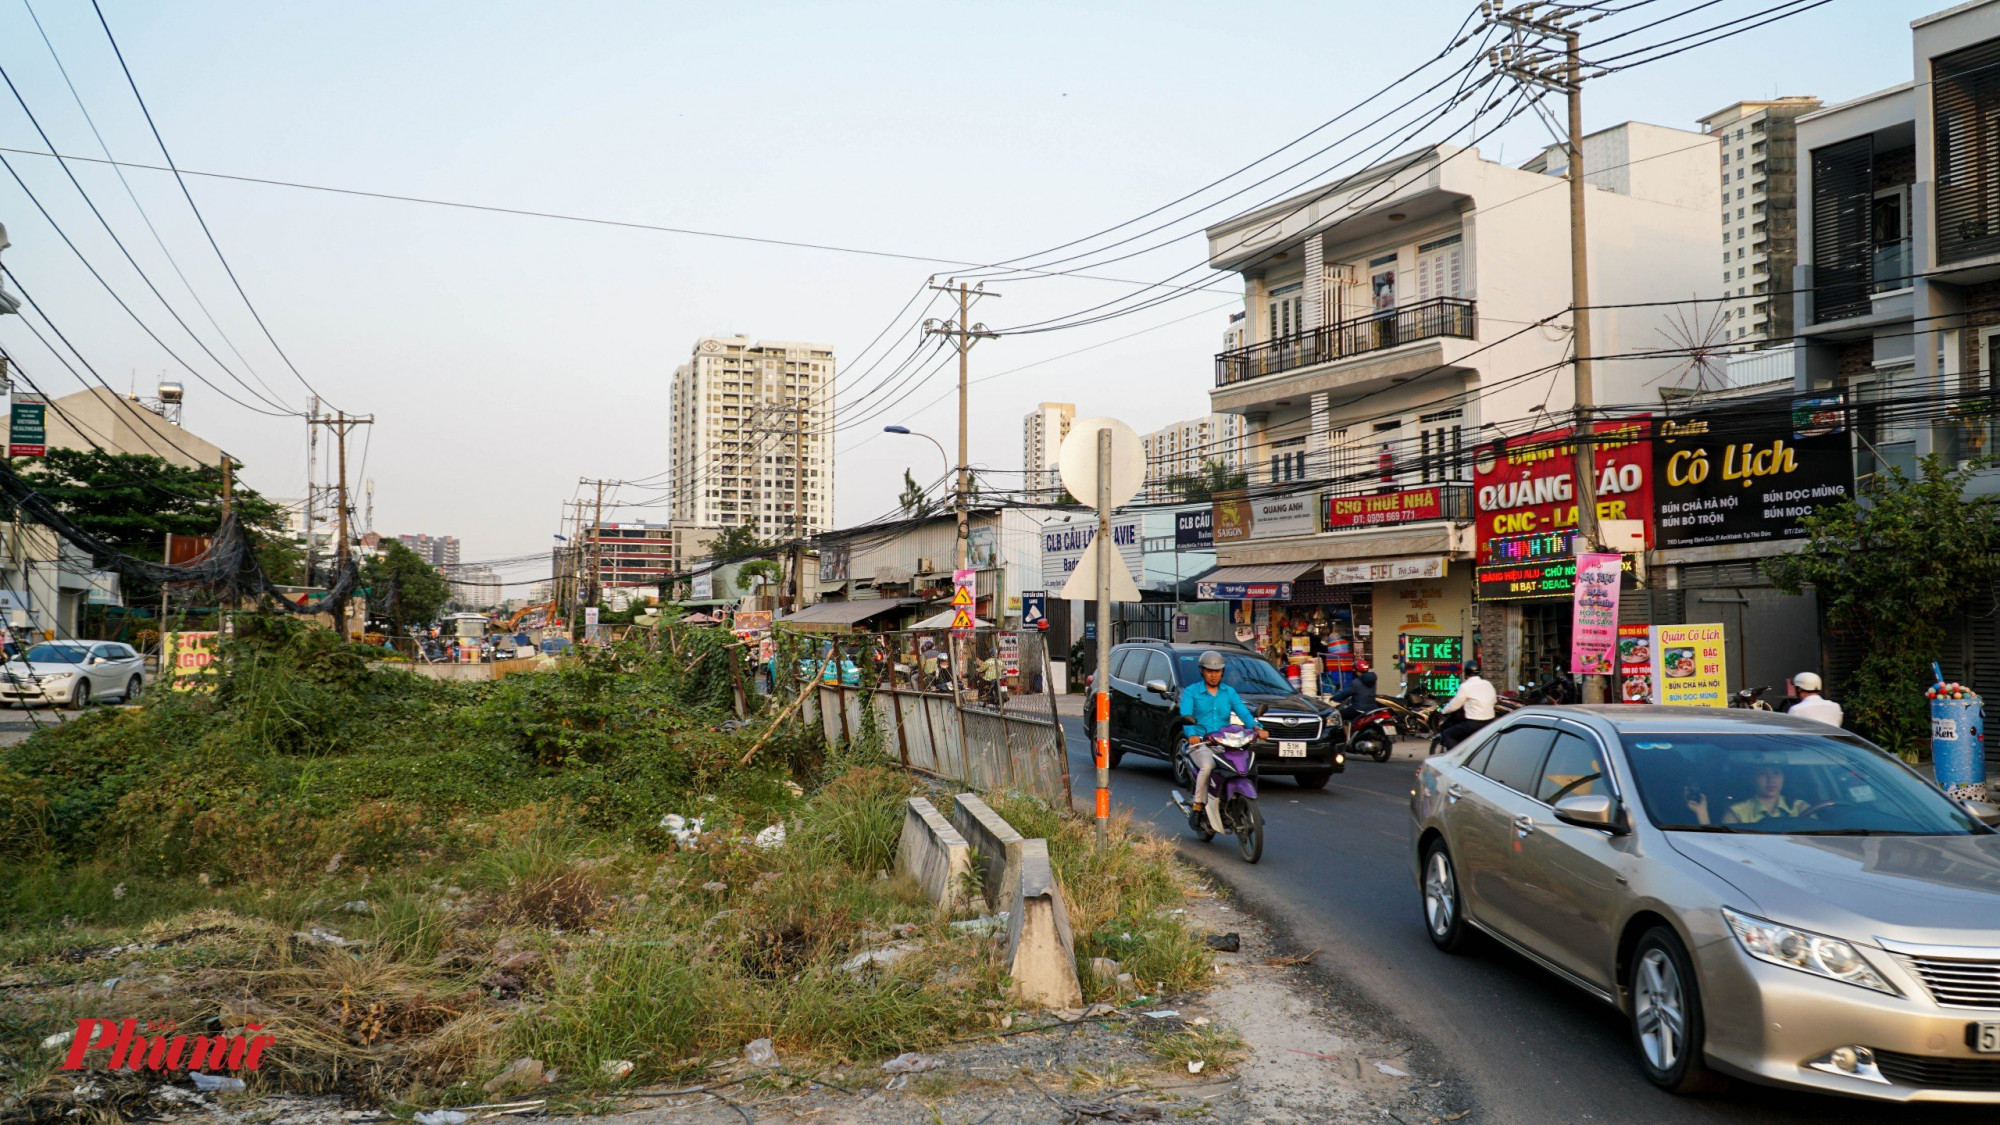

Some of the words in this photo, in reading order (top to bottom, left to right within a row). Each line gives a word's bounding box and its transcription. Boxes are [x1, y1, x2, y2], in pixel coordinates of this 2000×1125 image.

[1667, 448, 1710, 487] Cô
[1722, 440, 1798, 487] Lịch
[1478, 470, 1572, 512] QUẢNG
[1595, 459, 1643, 496] ÁO
[1763, 490, 1784, 503] BÚN
[1812, 484, 1845, 498] MÙNG
[1263, 504, 1288, 514] QUANG
[1288, 502, 1303, 512] ANH
[1336, 501, 1362, 514] CHO
[1366, 494, 1399, 512] THUÊ
[1404, 490, 1434, 508] NHÀ
[1662, 502, 1680, 514] BÚN
[1682, 498, 1702, 512] CHẢ
[1704, 496, 1718, 509] HÀ
[1720, 495, 1738, 508] NỘI
[1402, 510, 1415, 520] 771
[1494, 511, 1536, 534] CNC
[1554, 500, 1627, 528] LAER
[1662, 516, 1680, 528] BÚN
[1682, 514, 1696, 526] BÒ
[1698, 512, 1724, 526] TRỘN
[1764, 506, 1784, 519] BÚN
[1180, 517, 1194, 530] CLB
[1046, 534, 1062, 552] CLB
[1114, 524, 1135, 546] AVIE
[1217, 528, 1243, 538] SAIGON
[1499, 538, 1541, 561] THỊNH
[1544, 534, 1567, 554] TÍN
[1523, 569, 1540, 579] ALU
[1510, 584, 1519, 592] IN
[1662, 630, 1686, 644] Quán
[1688, 629, 1699, 640] Cô
[1702, 629, 1720, 642] Lịch
[1434, 638, 1452, 658] KẾ
[1704, 664, 1720, 674] BIỆT
[1669, 681, 1681, 689] BÚN
[1683, 680, 1696, 689] CHẢ
[1698, 679, 1706, 688] HÀ
[1708, 679, 1720, 687] NỘI
